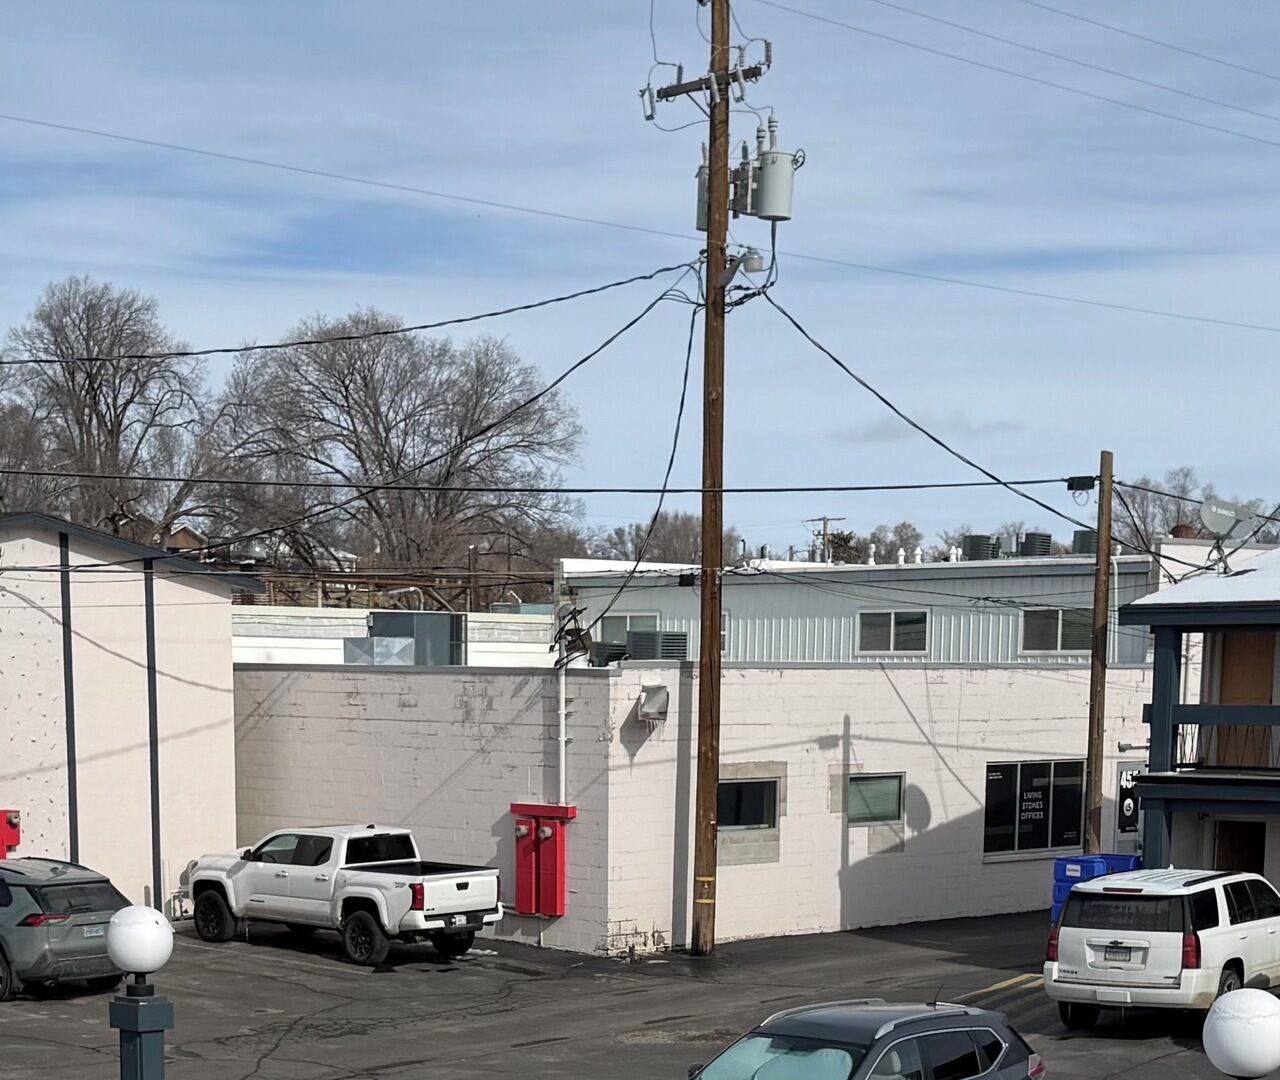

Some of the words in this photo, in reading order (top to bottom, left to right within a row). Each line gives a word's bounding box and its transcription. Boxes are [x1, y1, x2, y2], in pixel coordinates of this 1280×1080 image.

[1023, 791, 1043, 800] LIVING
[1022, 801, 1044, 810] STONES
[1020, 811, 1044, 820] OFFICES
